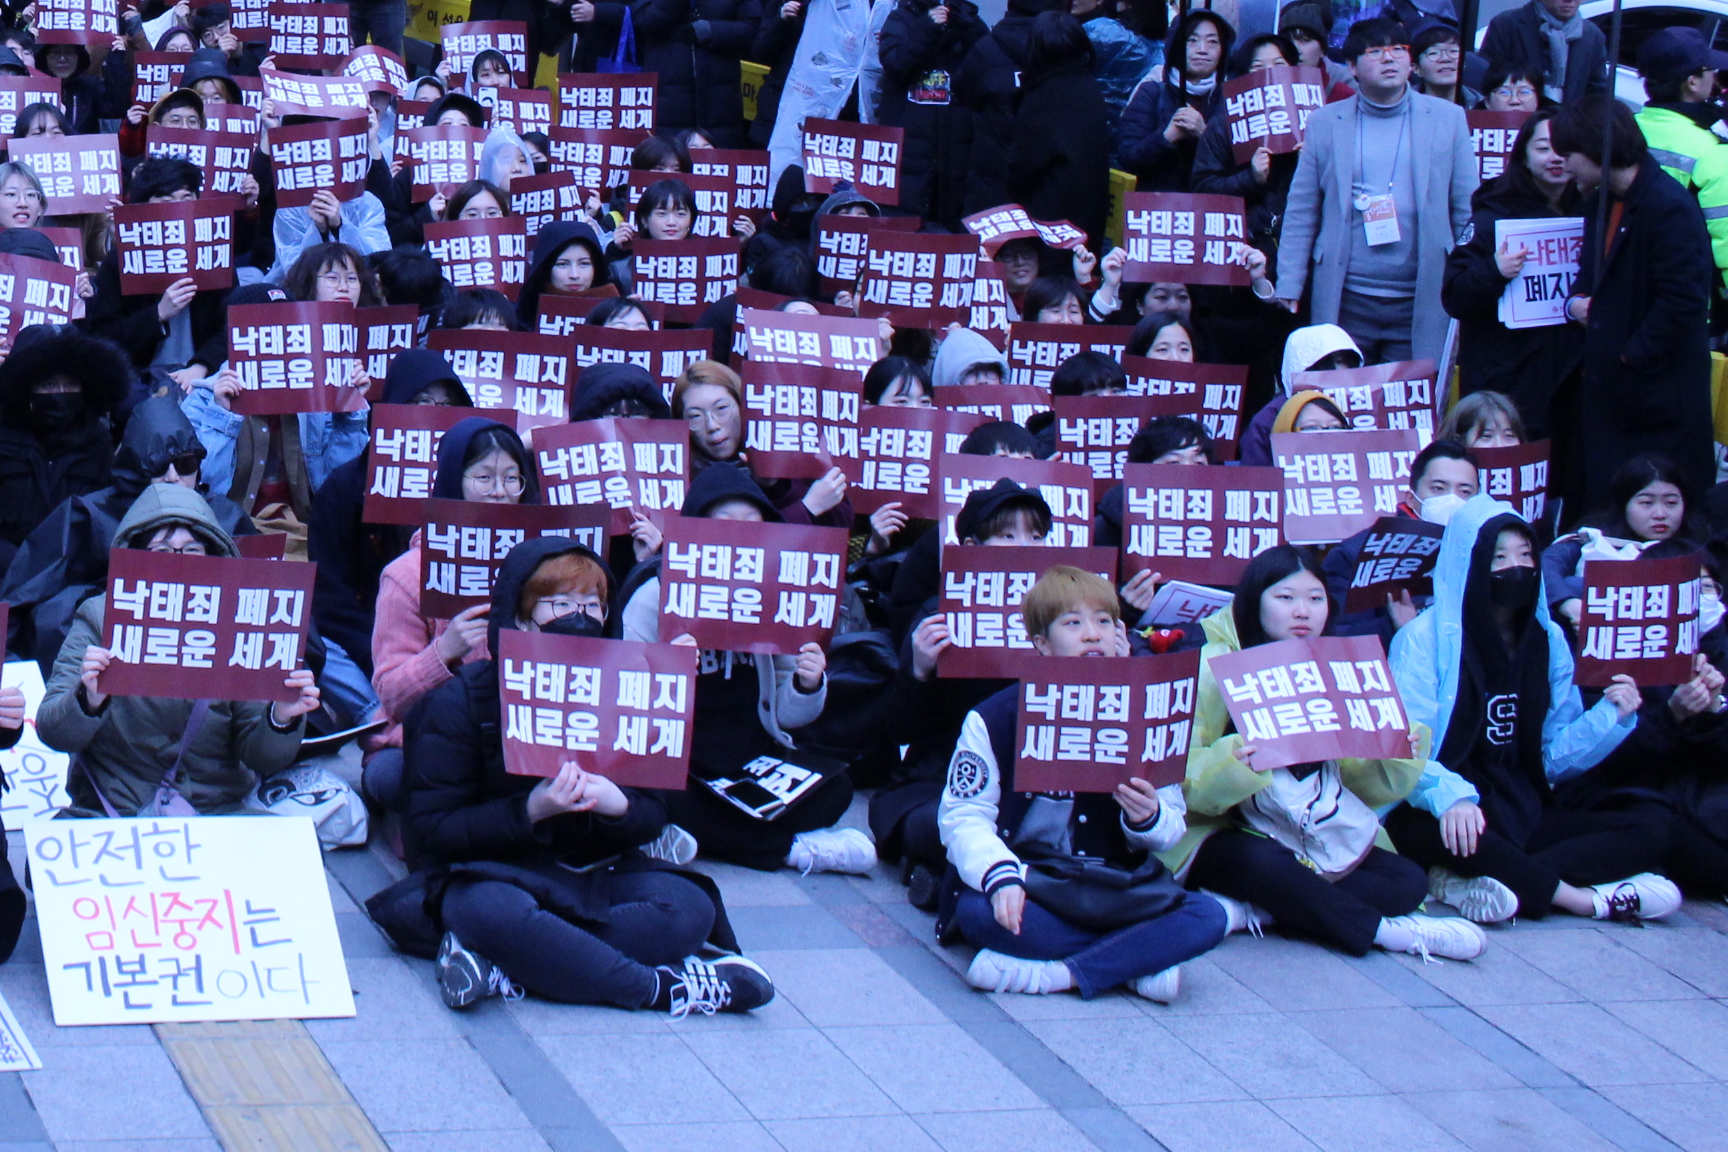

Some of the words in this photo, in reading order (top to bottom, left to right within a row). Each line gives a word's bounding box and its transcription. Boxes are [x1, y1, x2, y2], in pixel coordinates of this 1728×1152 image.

[560, 88, 611, 108] 낙태죄
[619, 87, 653, 109] 폐지
[805, 133, 856, 159] 낙태죄
[863, 139, 897, 165] 폐지
[118, 219, 183, 245] 낙태죄
[195, 215, 232, 243] 폐지
[1127, 212, 1195, 237] 낙태죄
[1204, 212, 1244, 238] 폐지
[121, 247, 186, 275] 새로운
[197, 245, 232, 270] 세계
[1127, 238, 1195, 264] 새로운
[1202, 241, 1243, 265] 세계
[667, 542, 764, 583] 낙태죄
[777, 549, 841, 589] 폐지
[113, 578, 221, 623] 낙태죄
[236, 588, 306, 629] 폐지
[664, 584, 761, 625] 새로운
[774, 591, 837, 629] 세계
[108, 623, 216, 667] 새로운
[235, 631, 299, 671] 세계
[504, 659, 600, 707] 낙태죄
[618, 671, 687, 713] 폐지
[1025, 680, 1129, 721] 낙태죄
[1145, 677, 1194, 719] 폐지
[1224, 661, 1321, 703] 낙태죄
[1329, 649, 1391, 693] 폐지
[504, 705, 600, 751] 새로운
[615, 715, 685, 758] 세계
[1240, 697, 1343, 743] 새로운
[1349, 693, 1407, 733] 세계
[1020, 723, 1128, 766] 새로운
[1141, 719, 1191, 765] 세계
[35, 822, 202, 890] 안전한
[71, 889, 293, 954] 임신중지는
[62, 953, 320, 1011] 기본권이다
